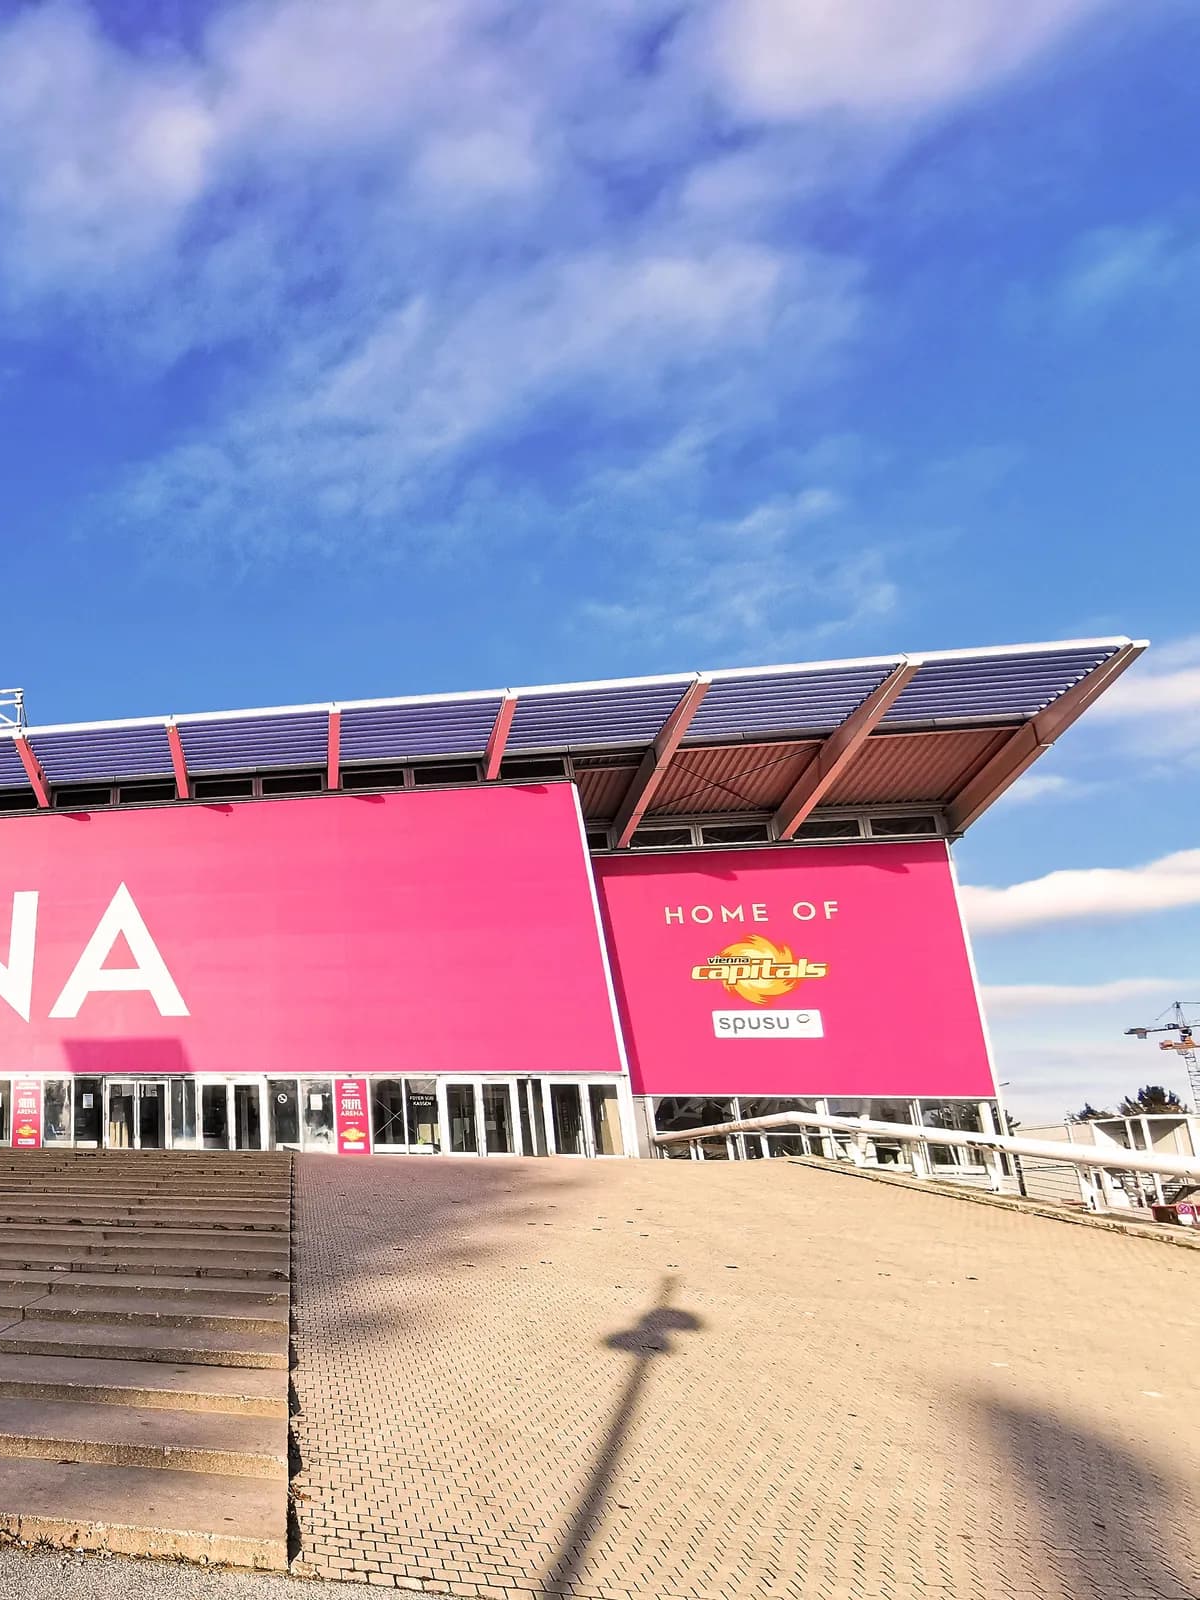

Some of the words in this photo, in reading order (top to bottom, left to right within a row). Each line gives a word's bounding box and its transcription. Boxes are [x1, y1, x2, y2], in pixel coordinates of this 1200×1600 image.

[664, 903, 769, 925] HOME
[792, 901, 839, 921] OF
[691, 957, 828, 985] capitals
[707, 955, 751, 966] vienna
[719, 1016, 790, 1034] spusu
